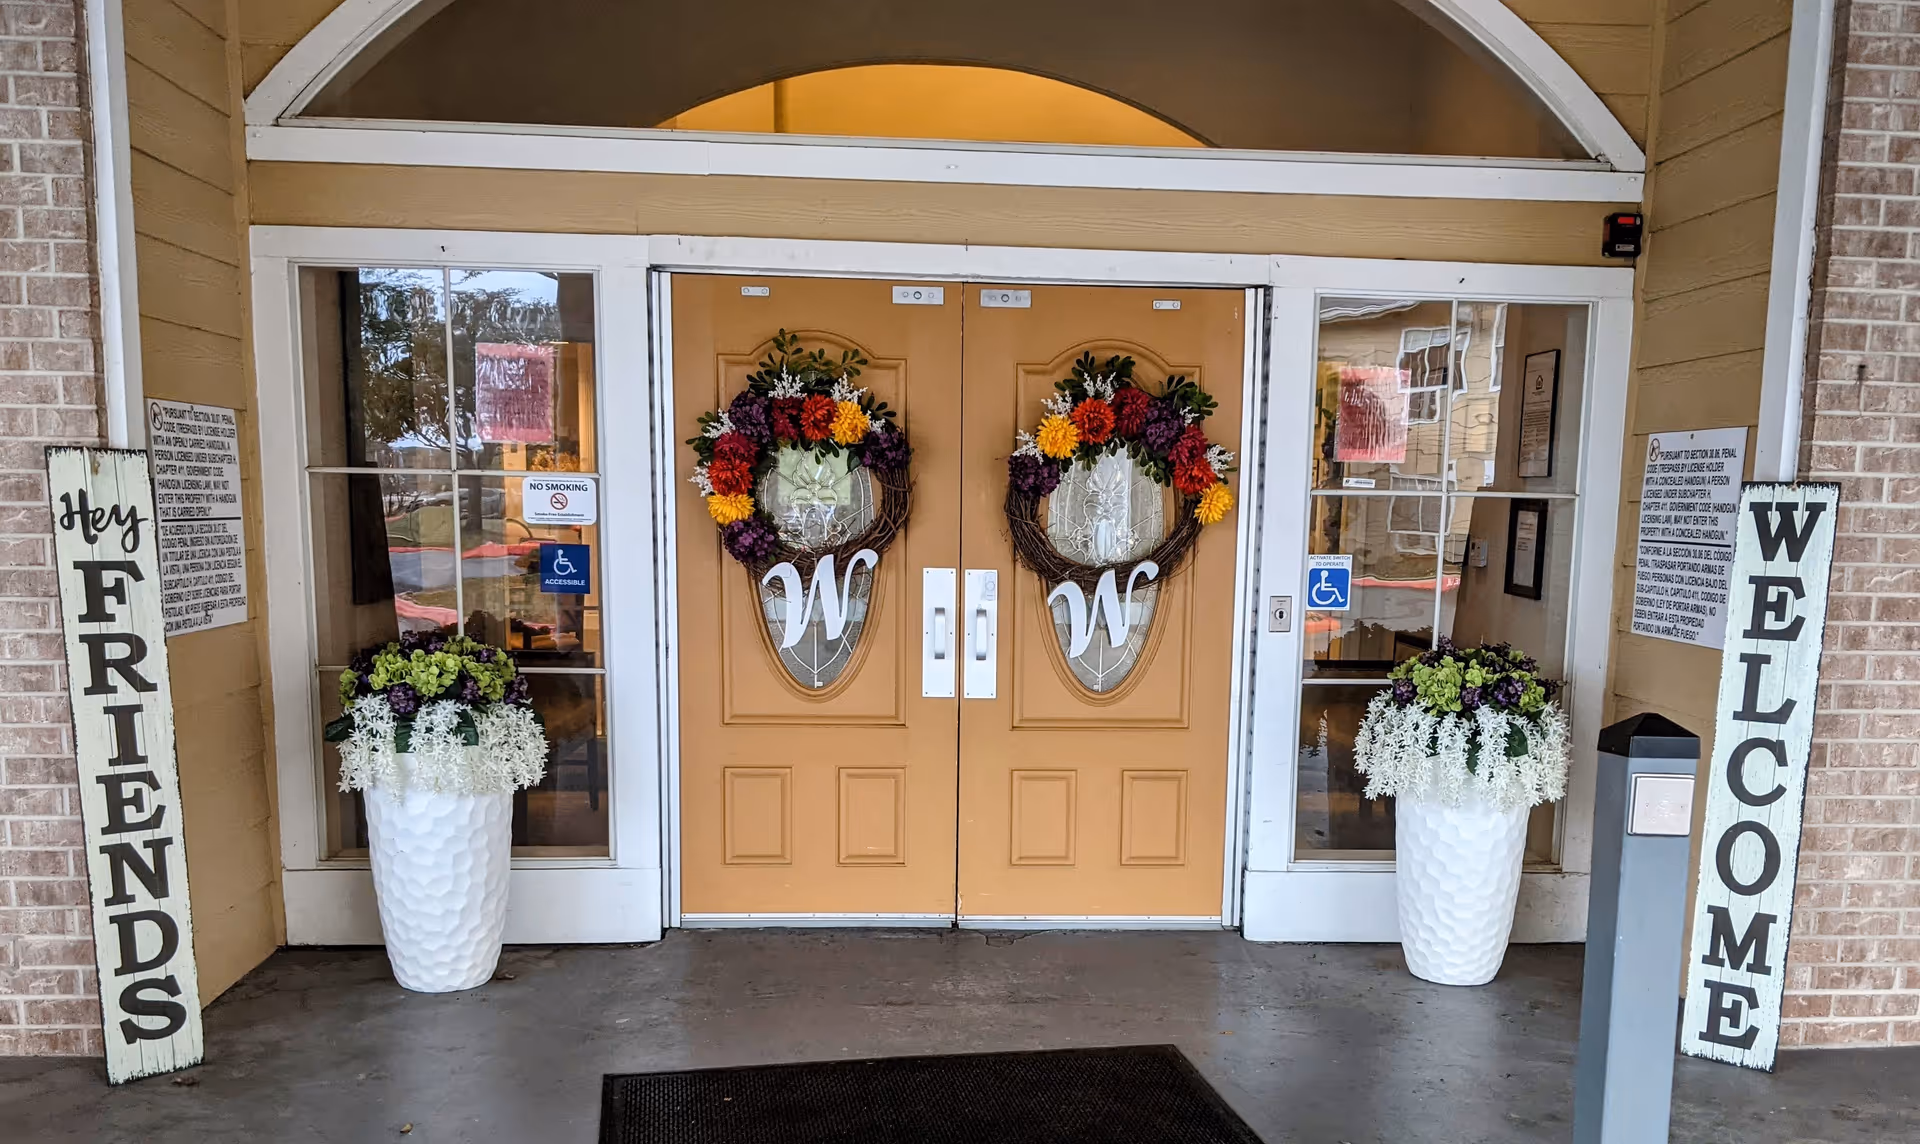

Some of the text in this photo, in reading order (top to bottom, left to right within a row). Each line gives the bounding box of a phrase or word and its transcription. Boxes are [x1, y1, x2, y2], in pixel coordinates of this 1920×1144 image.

[164, 422, 176, 432] CODE
[204, 426, 220, 437] LICENSE
[155, 450, 173, 461] PERSON
[174, 451, 193, 462] LICENSED
[194, 452, 207, 463] UNDER
[1684, 450, 1690, 460] TO
[1690, 449, 1709, 459] SECTION
[1722, 448, 1737, 458] PENAL
[156, 464, 177, 475] CHAPTER
[187, 466, 212, 476] GOVERNMENT
[1647, 464, 1657, 474] CODE
[1658, 463, 1680, 474] (TRESPASS
[1681, 463, 1687, 473] BY
[1687, 462, 1705, 472] LICENSE
[182, 480, 202, 490] LICENSING
[545, 483, 588, 491] SMOKING
[1645, 477, 1654, 485] WITH
[1659, 477, 1684, 485] CONCEALED
[1711, 476, 1730, 485] PERSON
[158, 494, 174, 504] ENTER
[174, 494, 184, 504] THIS
[185, 494, 205, 504] PROPERTY
[1644, 489, 1662, 499] LICENSED
[1663, 489, 1678, 499] UNDER
[1678, 489, 1707, 499] SUBCHAPTER
[159, 507, 171, 517] THAT
[1642, 502, 1661, 511] CHAPTER
[1669, 502, 1699, 512] GOVERNMENT
[1699, 502, 1711, 512] CODE
[1712, 503, 1736, 514] (HANDGUN
[60, 488, 148, 553] Hey
[1641, 514, 1661, 524] LICENSING
[1674, 515, 1683, 524] MAY
[1684, 515, 1692, 525] NOT
[1693, 516, 1707, 526] ENTER
[1708, 516, 1719, 526] THIS
[1640, 527, 1660, 536] PROPERTY
[1661, 527, 1671, 537] WITH
[1676, 528, 1701, 538] CONCEALED
[1666, 547, 1672, 557] LA
[1704, 550, 1712, 560] DEL
[1639, 558, 1650, 568] PENAL
[1677, 561, 1700, 573] PORTANDO
[1701, 564, 1718, 575] ARMAS
[1718, 565, 1725, 575] DE
[1652, 572, 1674, 583] PERSONAS
[1675, 575, 1684, 585] CON
[1685, 575, 1704, 587] LICENCIA
[1705, 578, 1718, 589] BAJO
[1718, 579, 1728, 590] DEL
[762, 548, 879, 648] W
[1670, 588, 1691, 599] CAPITULO
[1701, 591, 1719, 603] CODIGO
[1719, 593, 1726, 604] DE
[1047, 562, 1160, 659] W
[1635, 596, 1655, 608] GOBIERNO
[1666, 600, 1672, 610] DE
[1673, 602, 1690, 612] PORTAR
[1708, 607, 1717, 617] NO
[1634, 609, 1647, 619] DEBEN
[1647, 610, 1664, 621] ENTRAR
[1669, 613, 1680, 624] ESTA
[1680, 615, 1704, 628] PROPIEDAD
[1633, 621, 1654, 633] PORTANDO
[1654, 624, 1660, 634] UN
[1660, 625, 1674, 636] ARMA
[1674, 627, 1680, 637] DE
[1698, 502, 1826, 1050] WELCOME
[73, 560, 187, 1045] FRIENDS
